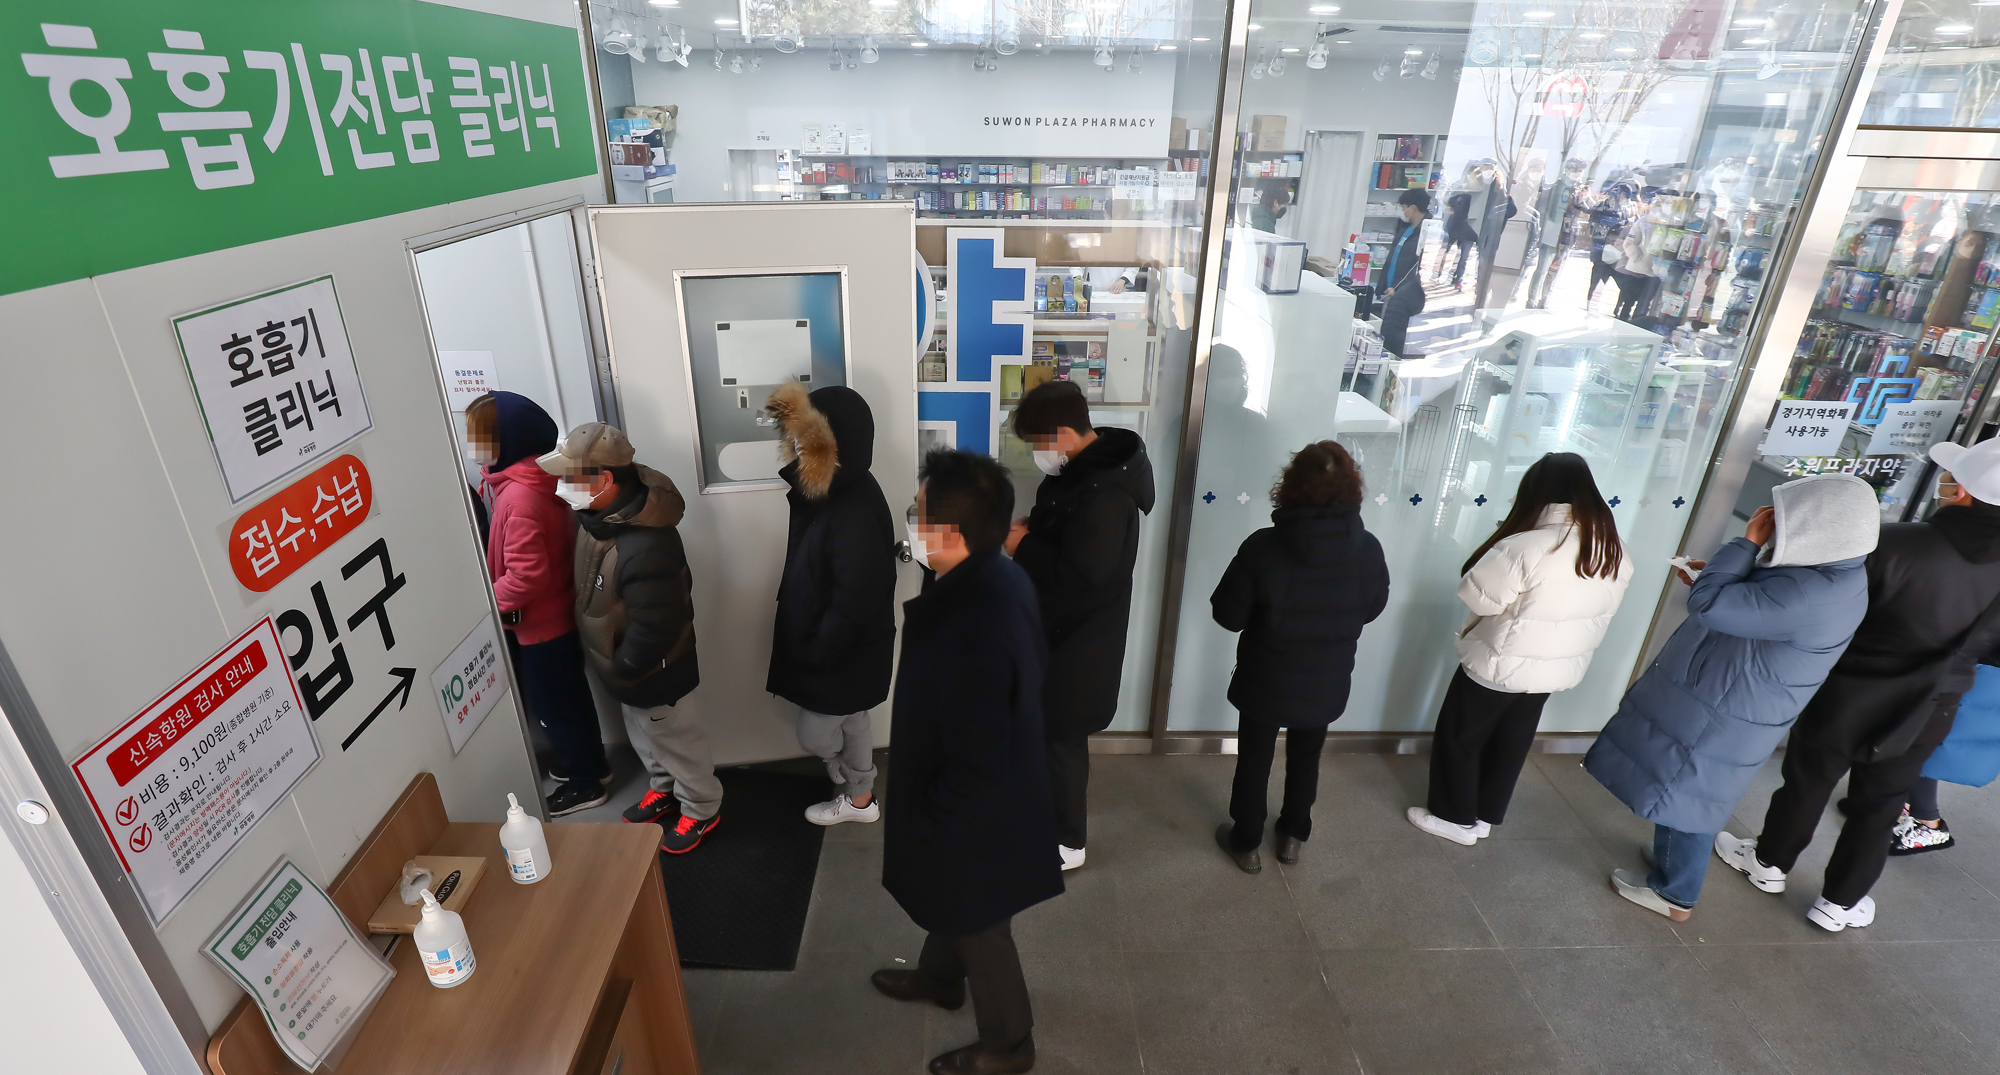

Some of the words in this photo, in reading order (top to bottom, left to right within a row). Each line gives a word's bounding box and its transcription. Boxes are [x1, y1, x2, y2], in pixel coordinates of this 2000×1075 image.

[448, 56, 560, 158] 클리닉
[984, 117, 1031, 126] SUWON
[1036, 117, 1077, 127] PLAZA
[1082, 118, 1155, 127] PHARMACY
[220, 308, 326, 388] 호흡기
[243, 369, 342, 457] 클리닉
[1782, 407, 1849, 419] 경기지역화폐
[1785, 425, 1829, 437] 사용가능
[239, 465, 364, 579] 접수,수납
[276, 537, 407, 722] 입구
[463, 655, 479, 677] 호흡기
[467, 664, 485, 689] 점심시간
[129, 704, 193, 766] 신속항원
[193, 678, 224, 712] 검사
[225, 654, 254, 687] 안내
[457, 704, 468, 724] 오후
[470, 690, 480, 707] 1시
[486, 672, 495, 688] 2시
[138, 773, 169, 804] 비용
[257, 686, 274, 704] 기준)
[151, 774, 206, 831] 결과확인
[215, 749, 236, 774] 검사
[236, 739, 247, 753] 후
[248, 715, 272, 744] 1시간
[274, 700, 291, 721] 소요
[214, 802, 225, 815] PCR
[236, 924, 264, 954] 호흡기
[259, 906, 278, 927] 전담
[273, 882, 298, 910] 클리닉
[437, 886, 450, 902] GLO
[264, 910, 297, 948] 출입안내
[290, 939, 300, 952] 사용
